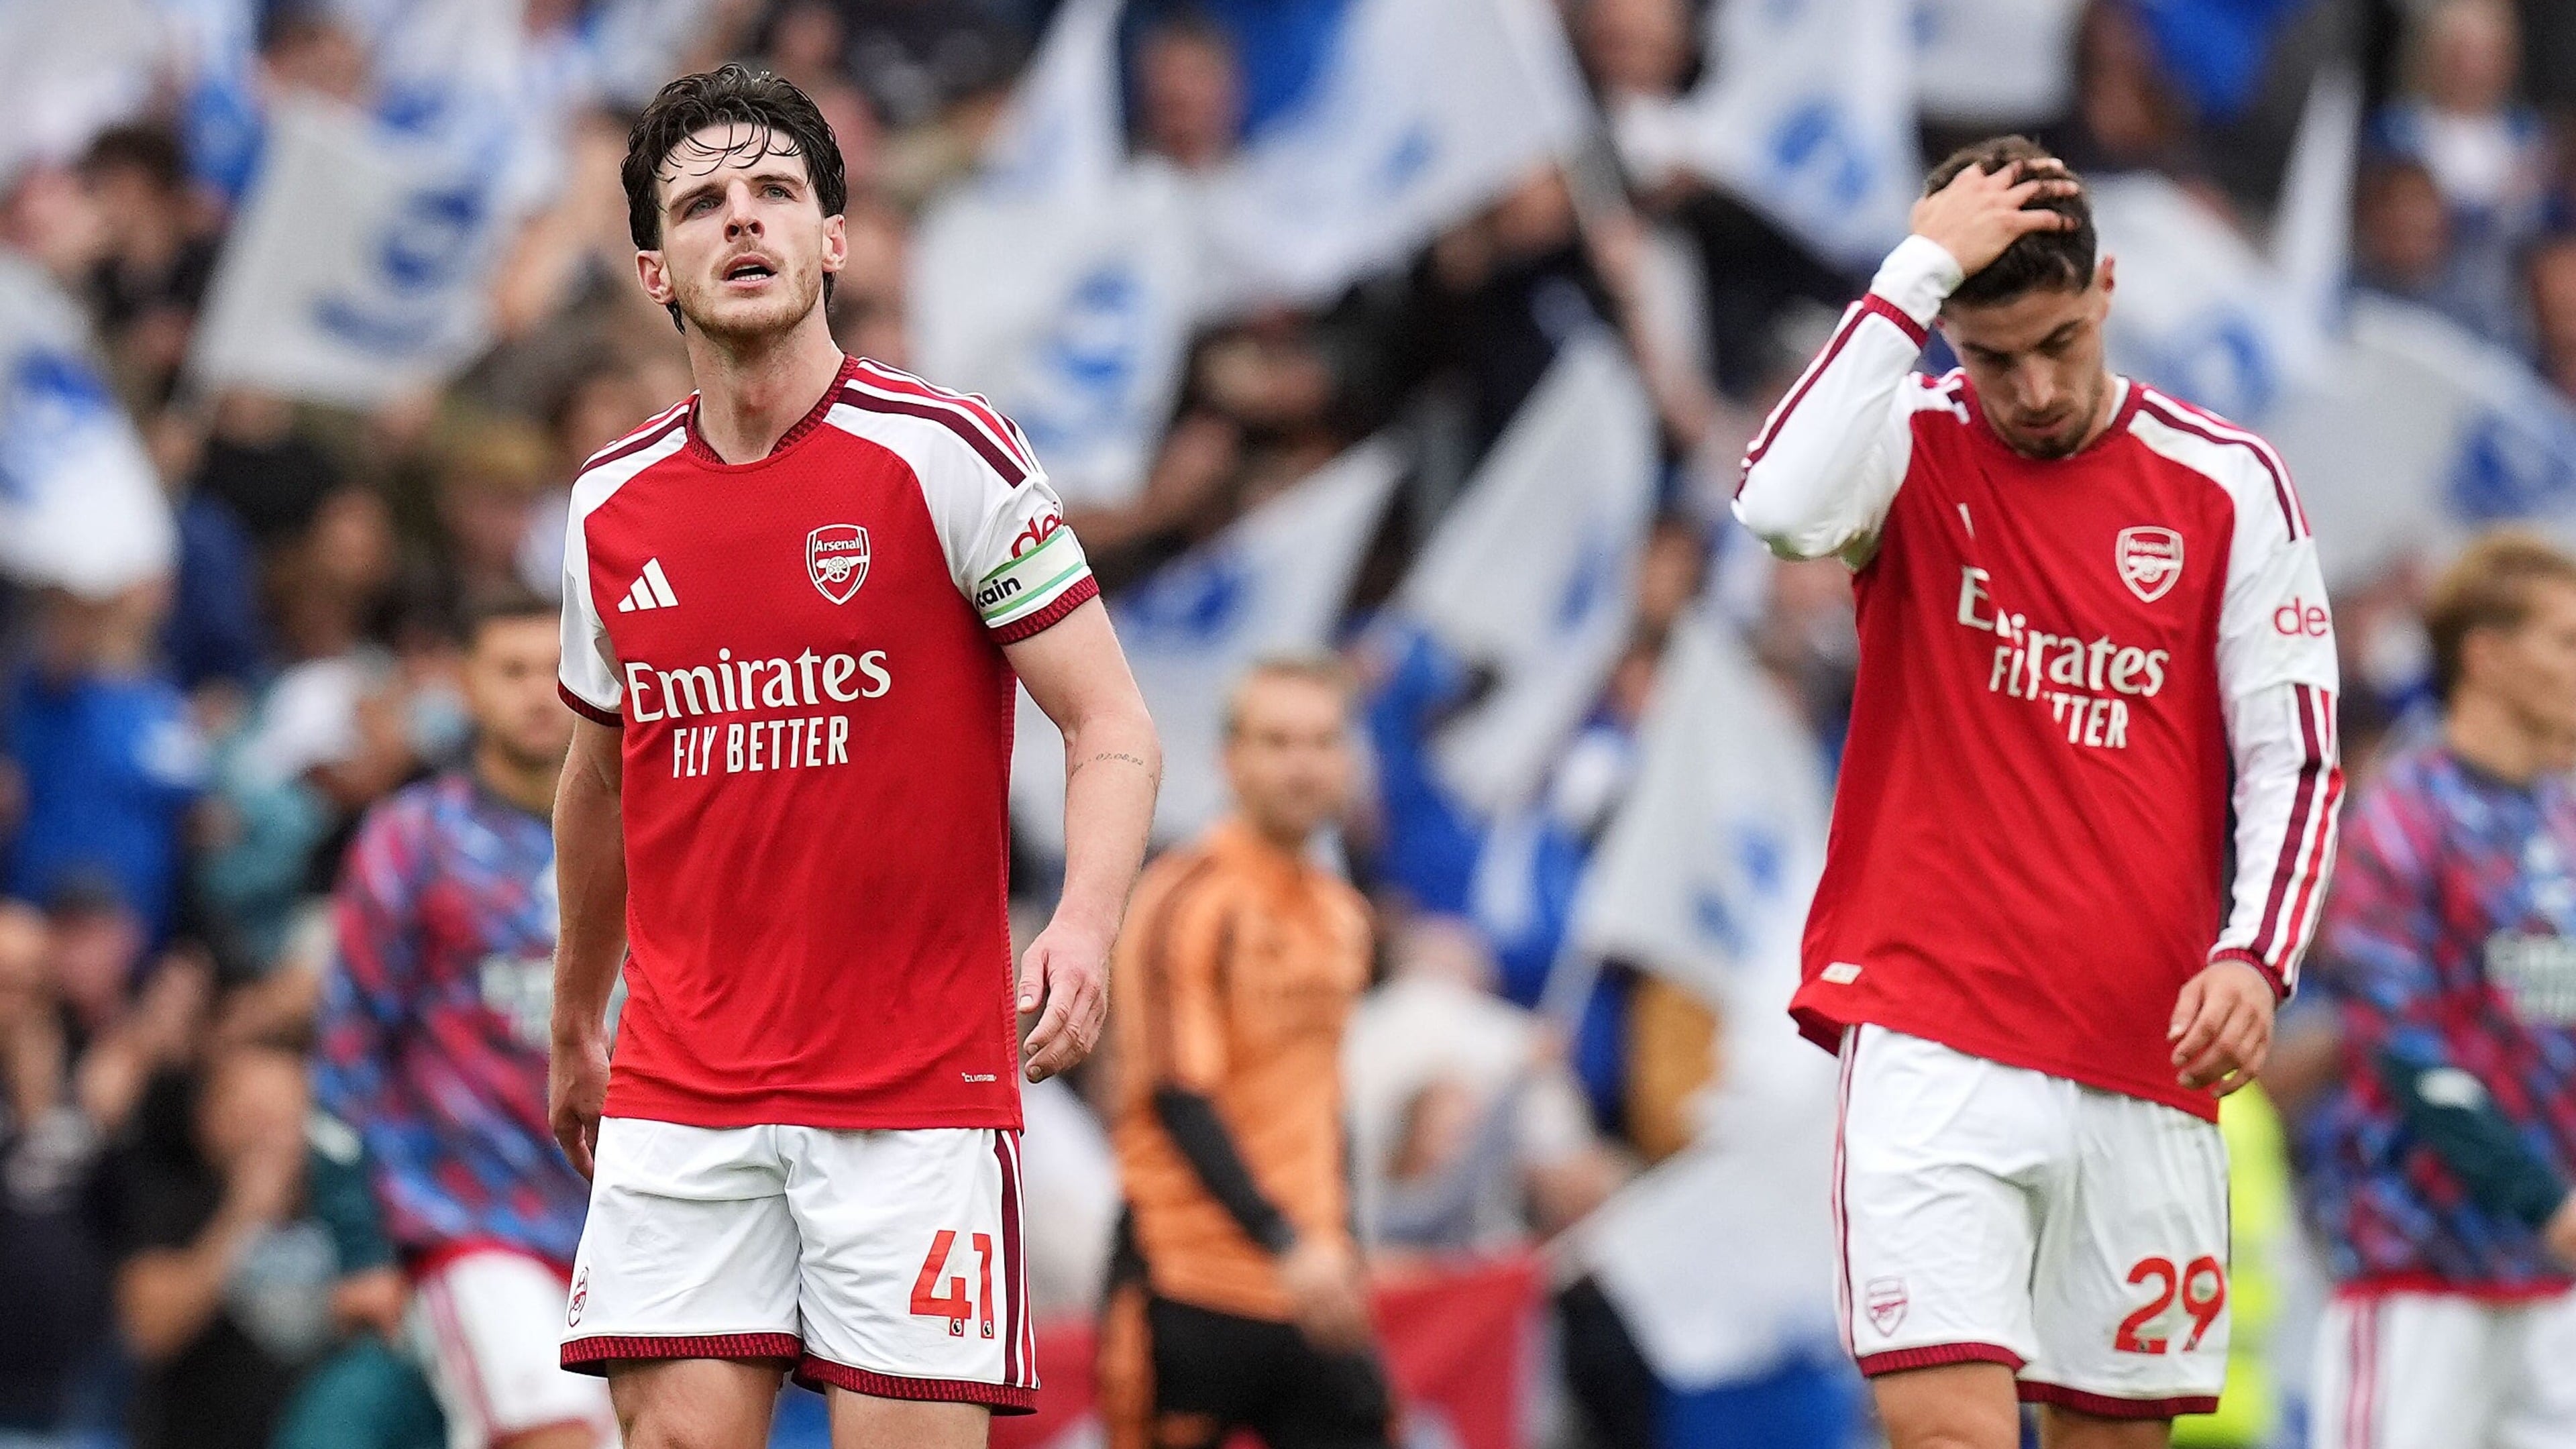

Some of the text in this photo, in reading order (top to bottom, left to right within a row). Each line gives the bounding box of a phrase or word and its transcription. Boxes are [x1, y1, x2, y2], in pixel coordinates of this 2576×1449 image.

[815, 537, 860, 552] Arsenal
[1011, 514, 1062, 559] de
[625, 646, 891, 722] Emirates
[673, 715, 849, 777] FLY BETTER
[2042, 691, 2129, 749] TTER
[910, 1230, 994, 1340] 41
[2115, 1256, 2225, 1354] 29
